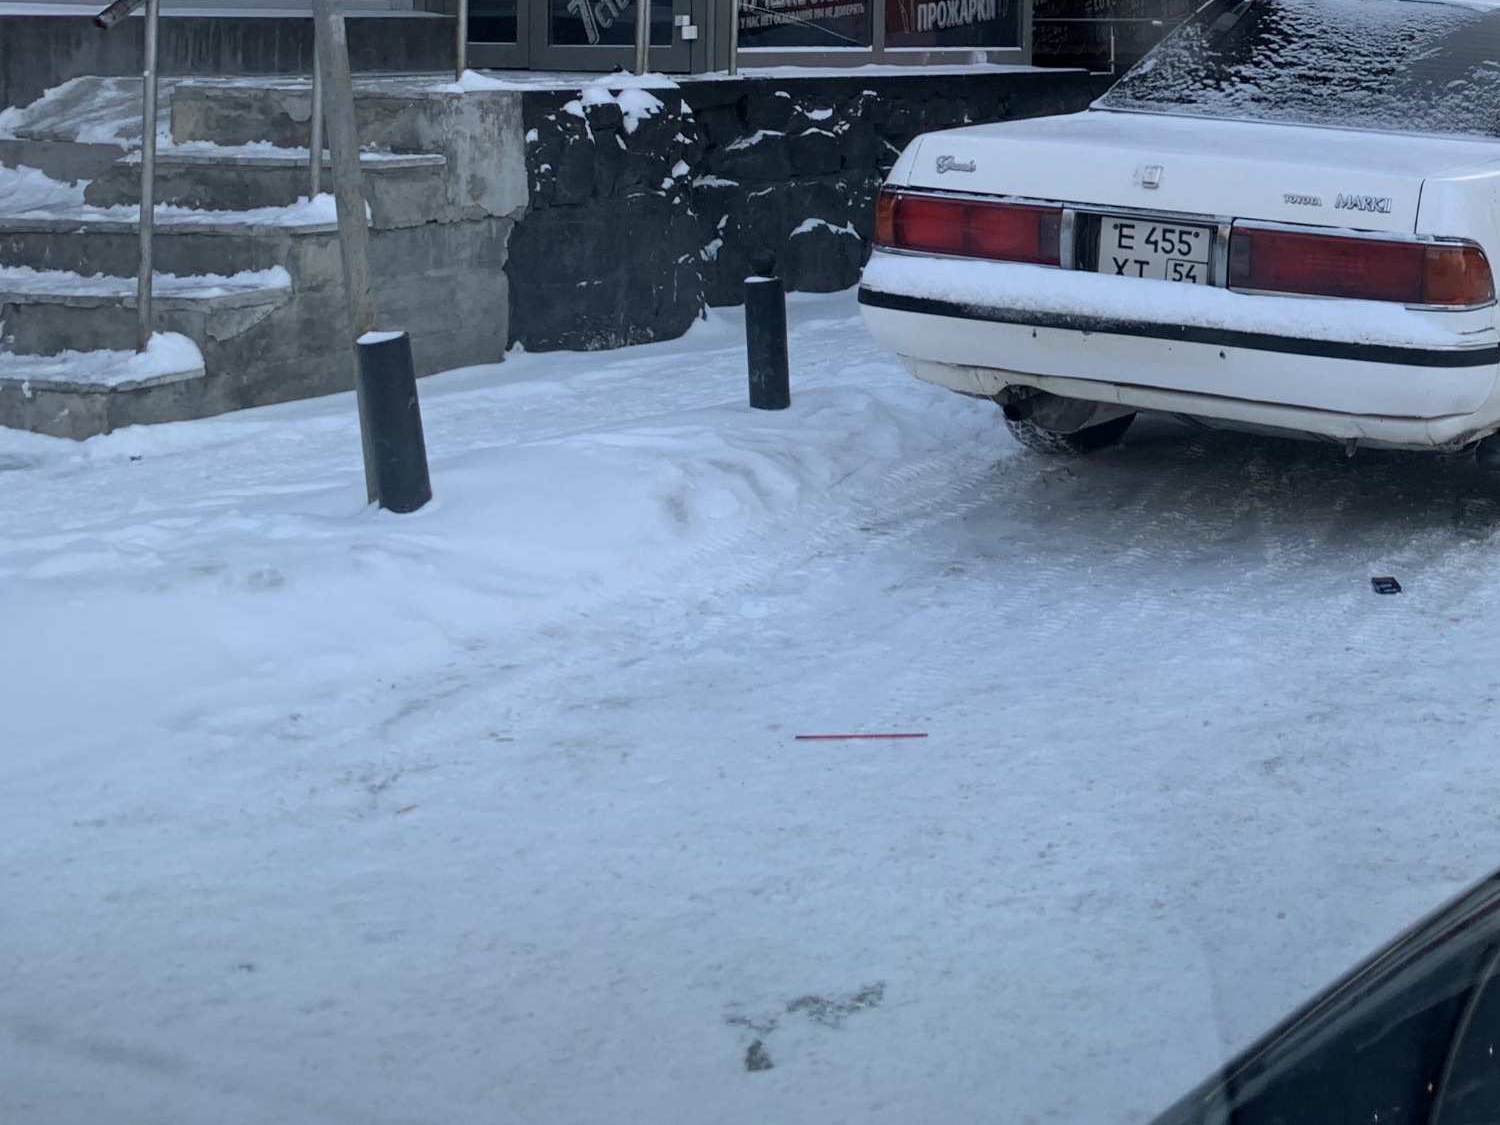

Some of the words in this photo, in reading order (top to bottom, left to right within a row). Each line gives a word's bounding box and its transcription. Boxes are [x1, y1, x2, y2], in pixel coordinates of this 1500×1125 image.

[1283, 194, 1322, 206] TOYOTA
[1145, 227, 1192, 256] 455
[1172, 263, 1197, 284] 54
